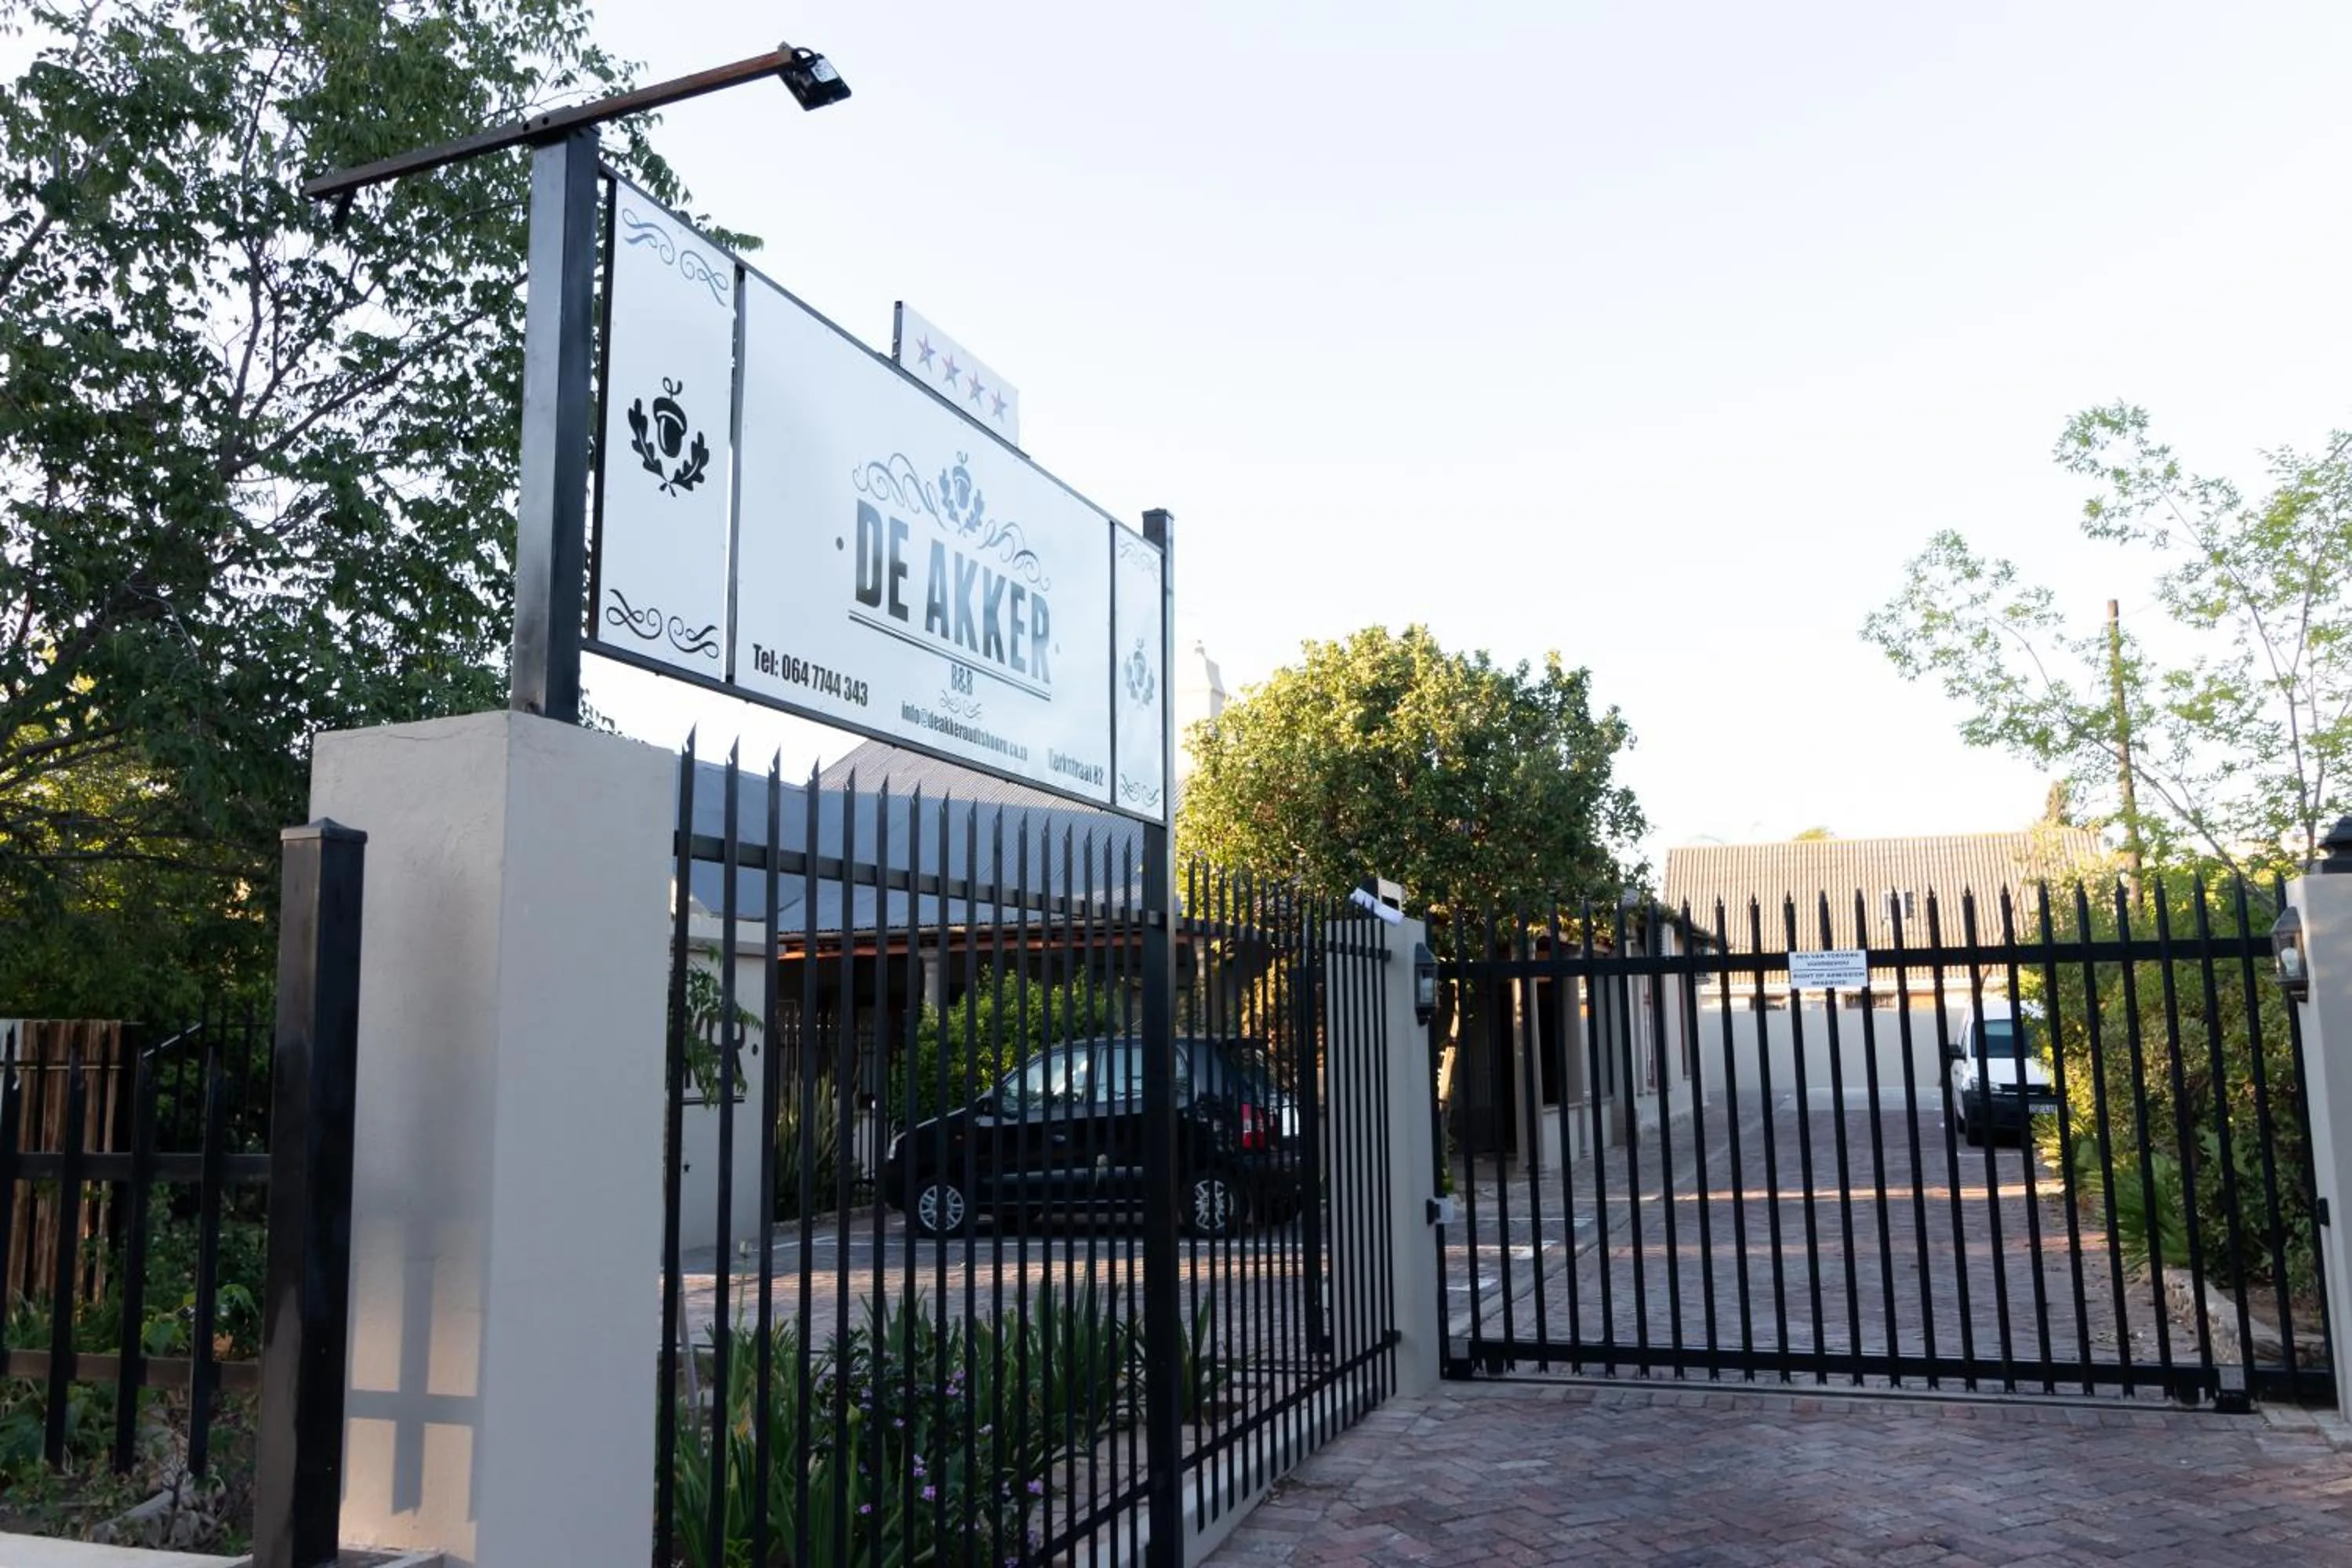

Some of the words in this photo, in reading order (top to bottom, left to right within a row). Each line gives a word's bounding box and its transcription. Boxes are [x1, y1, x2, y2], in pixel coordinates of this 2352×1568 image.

[855, 498, 909, 622] DE
[924, 539, 1051, 684] AKKER
[753, 642, 779, 677] Tel:
[782, 653, 810, 687] 064
[811, 664, 841, 699] 7744
[844, 675, 869, 707] 343
[951, 663, 973, 695] B&B
